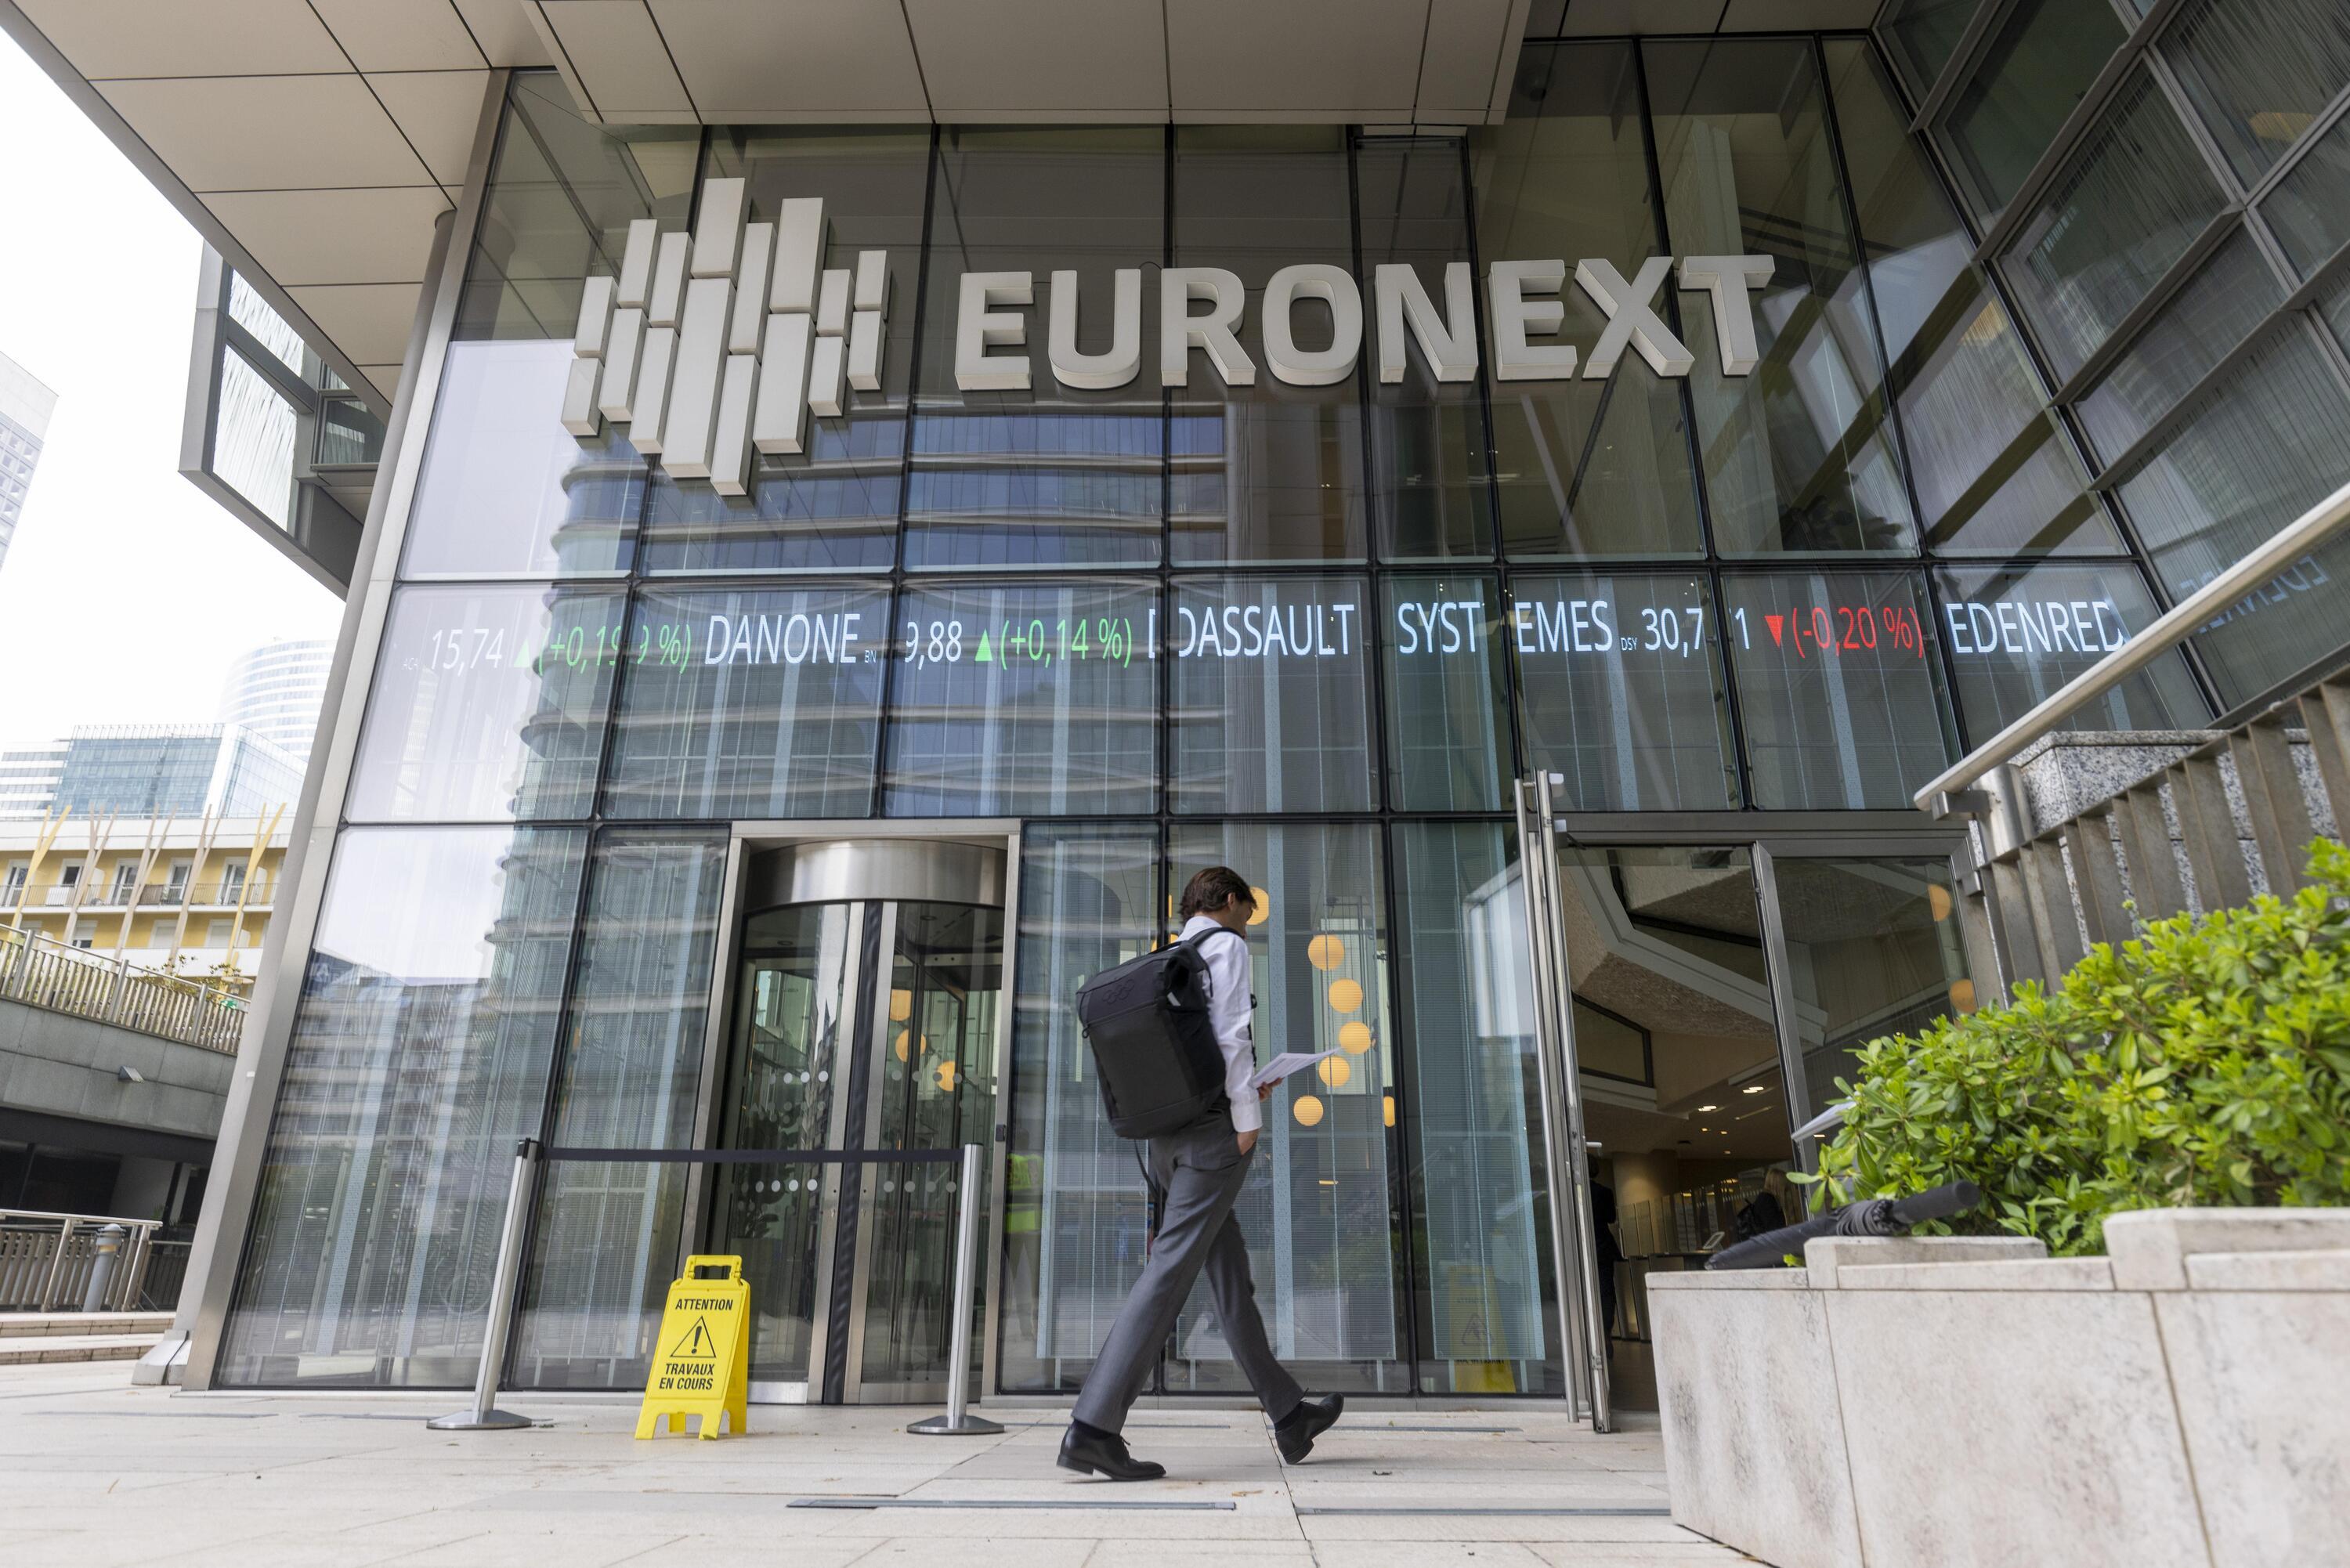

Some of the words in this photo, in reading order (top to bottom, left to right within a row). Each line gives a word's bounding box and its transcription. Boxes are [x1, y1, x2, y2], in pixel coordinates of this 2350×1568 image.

[955, 254, 1776, 392] EURONEXT
[432, 628, 504, 676] 15,74
[705, 612, 861, 665] DANONE
[864, 649, 877, 663] BN
[1620, 636, 1638, 652] DSY
[1945, 600, 2126, 653] EDENRED
[675, 1299, 733, 1310] ATTENTION
[666, 1363, 714, 1375] TRAVAUX
[659, 1378, 674, 1389] EN
[677, 1378, 714, 1389] COURS
